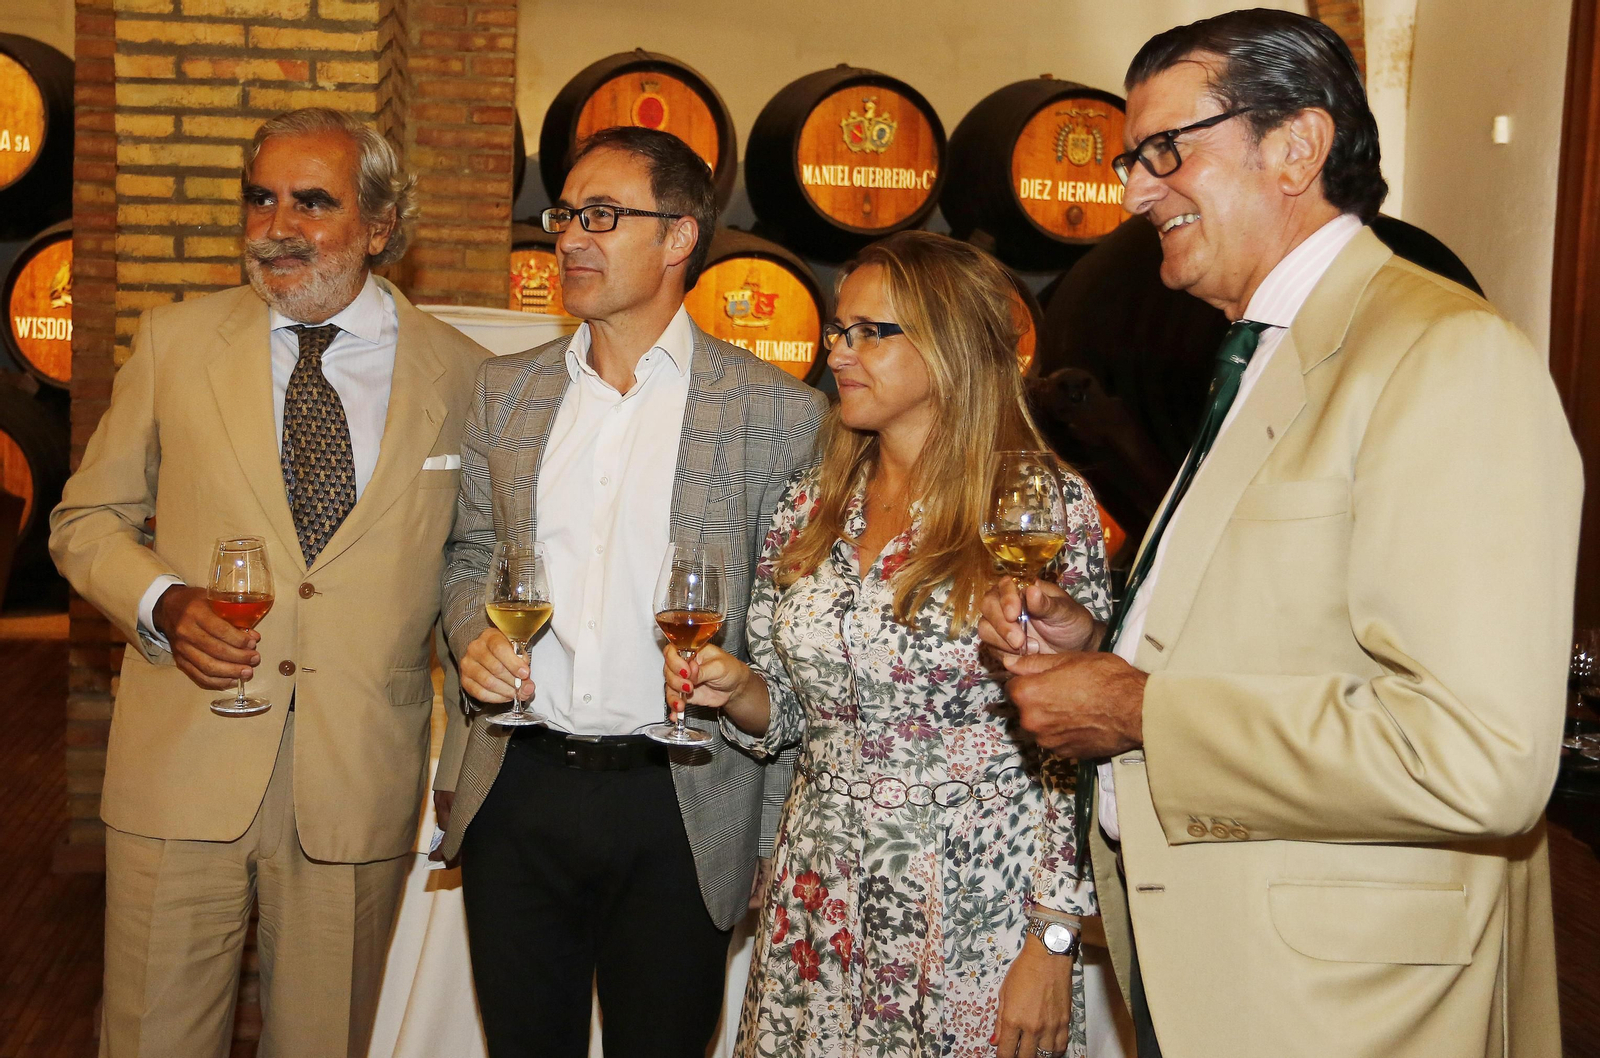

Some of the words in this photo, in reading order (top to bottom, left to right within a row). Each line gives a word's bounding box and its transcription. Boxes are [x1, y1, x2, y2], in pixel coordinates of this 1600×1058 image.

[14, 134, 31, 153] SA
[802, 164, 851, 187] MANUEL
[852, 167, 915, 190] GUERRERO
[1020, 178, 1052, 200] DIEZ
[755, 338, 814, 362] HUMBERT
